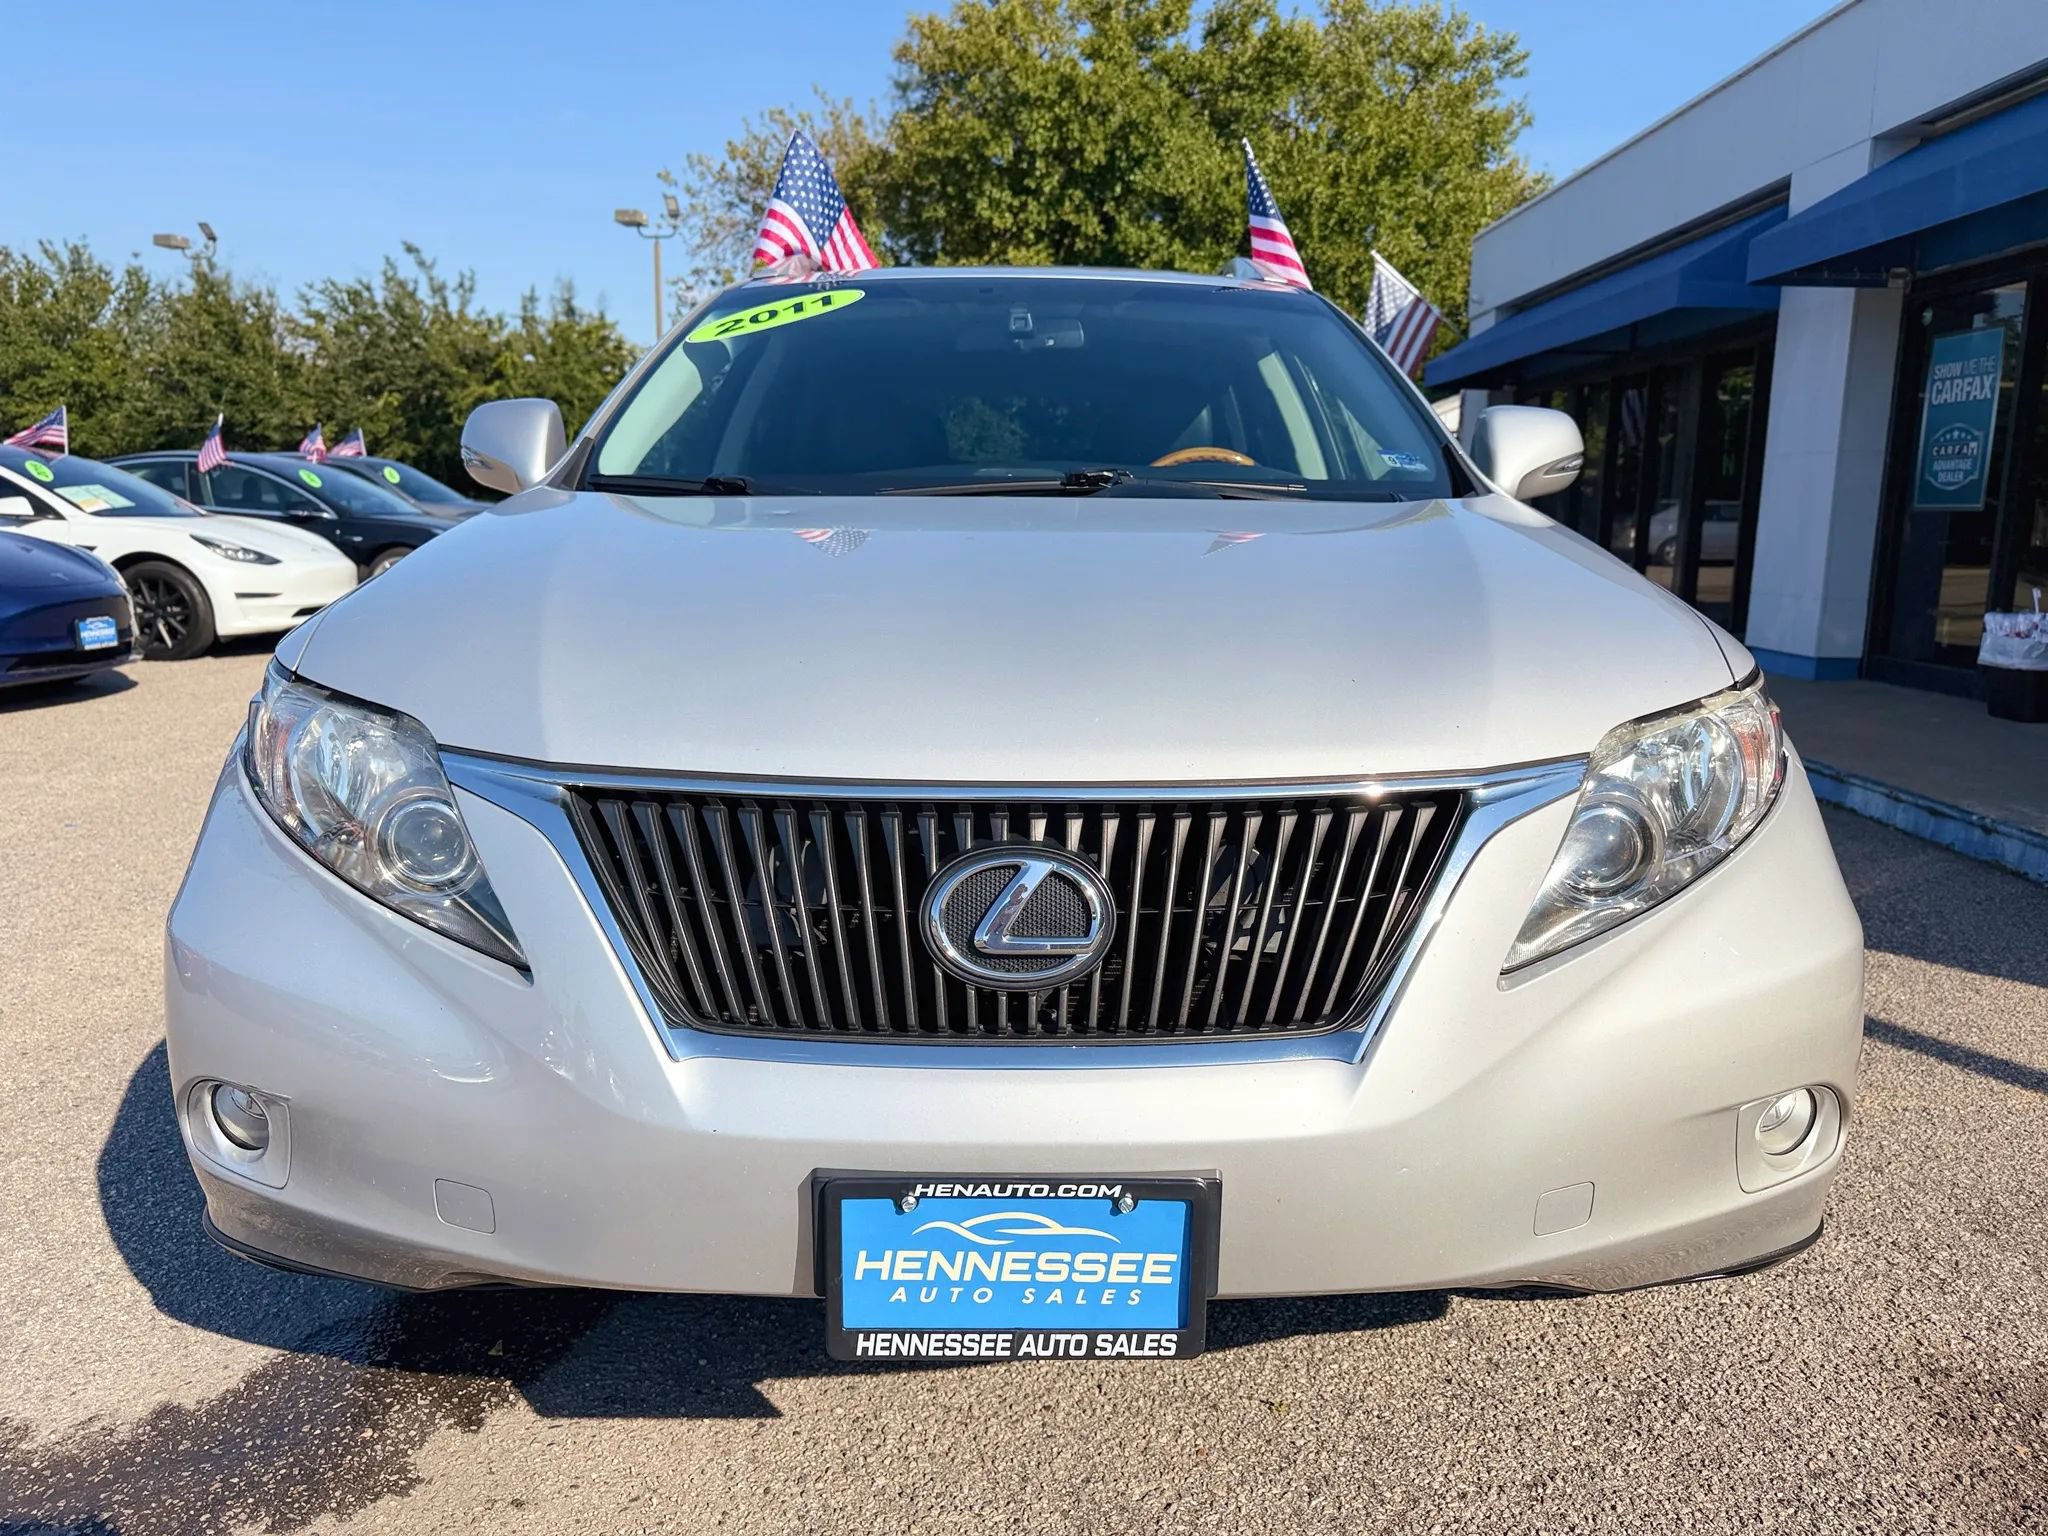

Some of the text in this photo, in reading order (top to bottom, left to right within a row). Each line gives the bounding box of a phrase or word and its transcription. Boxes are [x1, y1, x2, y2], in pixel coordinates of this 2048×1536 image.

[714, 295, 834, 338] 2011
[1933, 362, 1964, 380] SHOW
[1978, 355, 1996, 374] THE
[1931, 374, 1995, 405] CARFAX
[1932, 458, 1973, 471] ADVANTAGE
[1937, 470, 1964, 483] DEALER
[914, 1183, 1122, 1199] HENAUTO.COM
[854, 1249, 1178, 1285] HENNESSEE
[888, 1286, 1142, 1306] AUTO SALES
[856, 1333, 1178, 1357] HENNESSEE AUTO SALES
